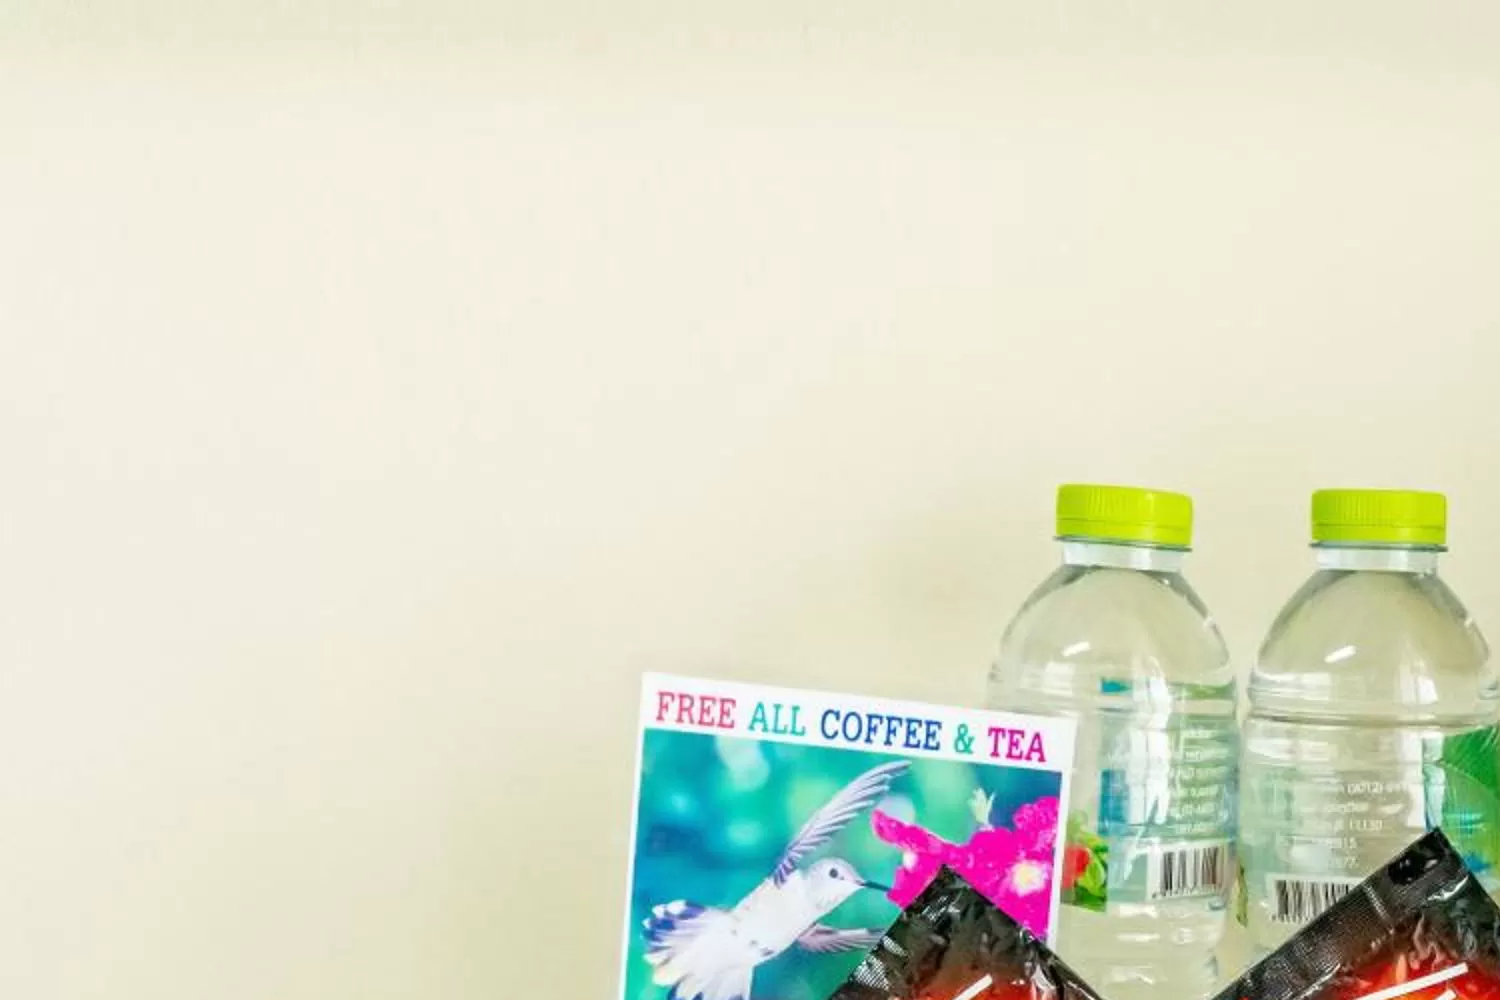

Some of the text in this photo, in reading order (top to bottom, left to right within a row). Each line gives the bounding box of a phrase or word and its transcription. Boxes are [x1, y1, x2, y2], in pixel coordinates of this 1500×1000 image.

[656, 690, 1047, 763] FREE ALL COFFEE & TEA
